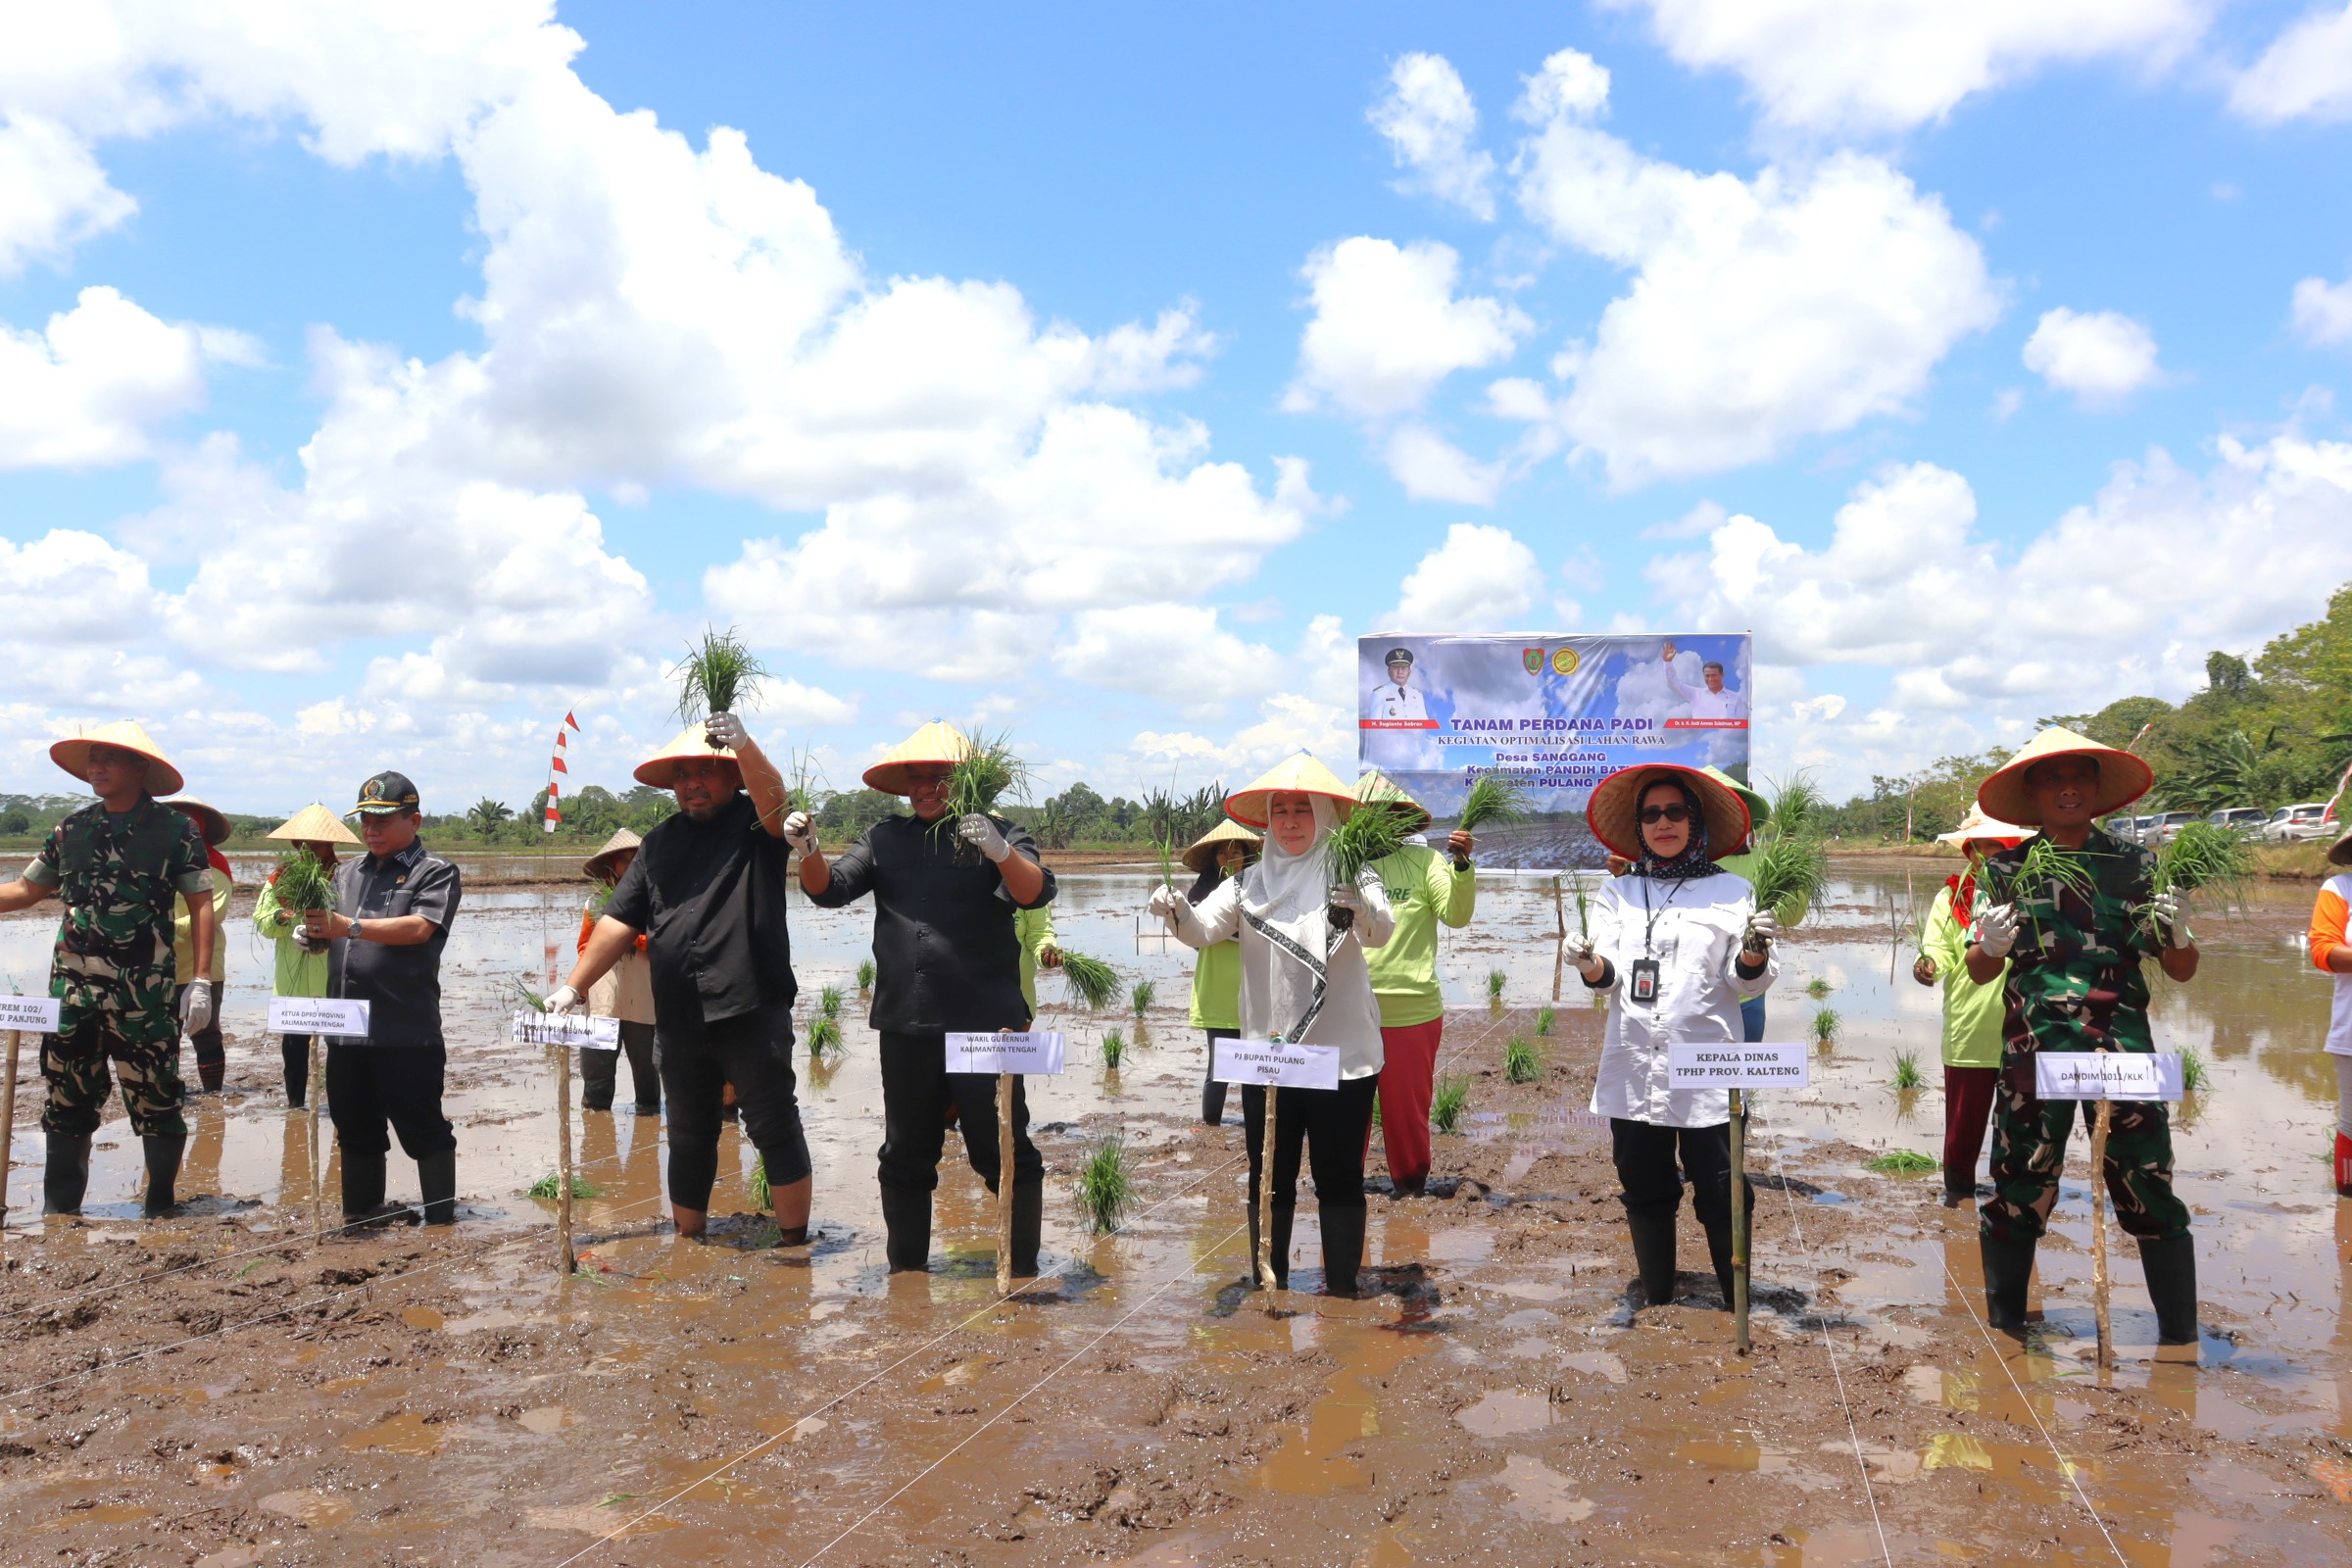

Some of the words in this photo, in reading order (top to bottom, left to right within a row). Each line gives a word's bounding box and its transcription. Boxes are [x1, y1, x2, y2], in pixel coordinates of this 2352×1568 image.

[1450, 718, 1513, 731] TANAM
[1519, 718, 1605, 731] PERDANA
[1610, 718, 1653, 730] PADI
[1438, 736, 1498, 745] KEGIATAN
[1500, 736, 1585, 745] OPTIMALISASI
[1588, 736, 1629, 745] LAHAN
[1632, 736, 1666, 745] RAWA
[1495, 753, 1528, 762] Desa
[1532, 753, 1606, 762] SANGGANG
[1545, 765, 1596, 774] PANDIH
[1539, 778, 1593, 788] PULANG
[24, 1004, 42, 1014] 102/
[8, 1014, 48, 1024] PANJUNG
[1244, 1054, 1272, 1063] BUPATI
[1273, 1055, 1305, 1065] PULANG
[1696, 1053, 1741, 1062] KEPALA
[1743, 1053, 1780, 1061] DINAS
[1256, 1065, 1281, 1075] PISAU
[1675, 1067, 1706, 1076] TPHP
[1708, 1067, 1743, 1076] PROV.
[1746, 1066, 1800, 1076] KALTENG
[2061, 1072, 2100, 1081] DANDIM
[2101, 1072, 2144, 1082] 1011/KLK
